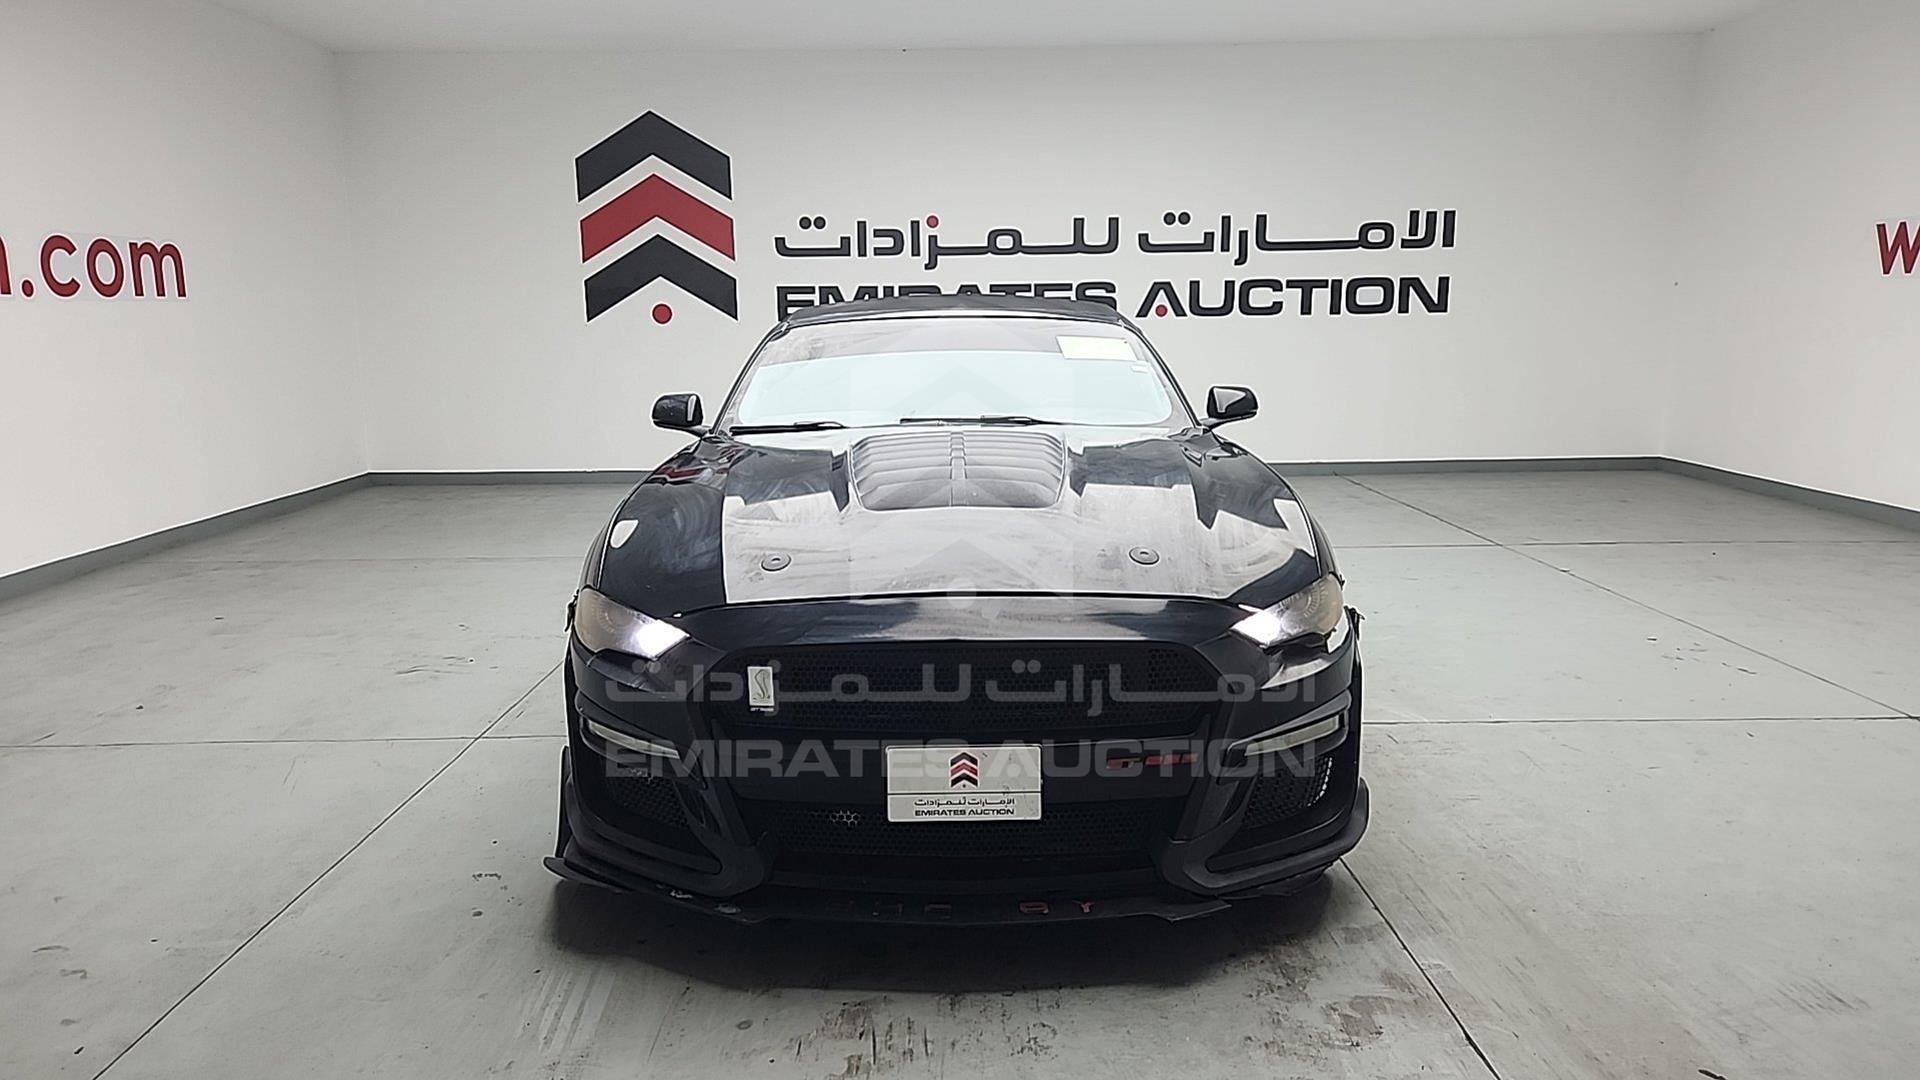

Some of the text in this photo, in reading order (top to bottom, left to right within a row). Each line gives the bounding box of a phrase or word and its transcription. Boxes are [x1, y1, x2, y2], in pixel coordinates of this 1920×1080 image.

[774, 210, 1456, 270] الامارات للمزادات
[1135, 276, 1450, 317] AUCTION
[968, 808, 1015, 816] AUCTION
